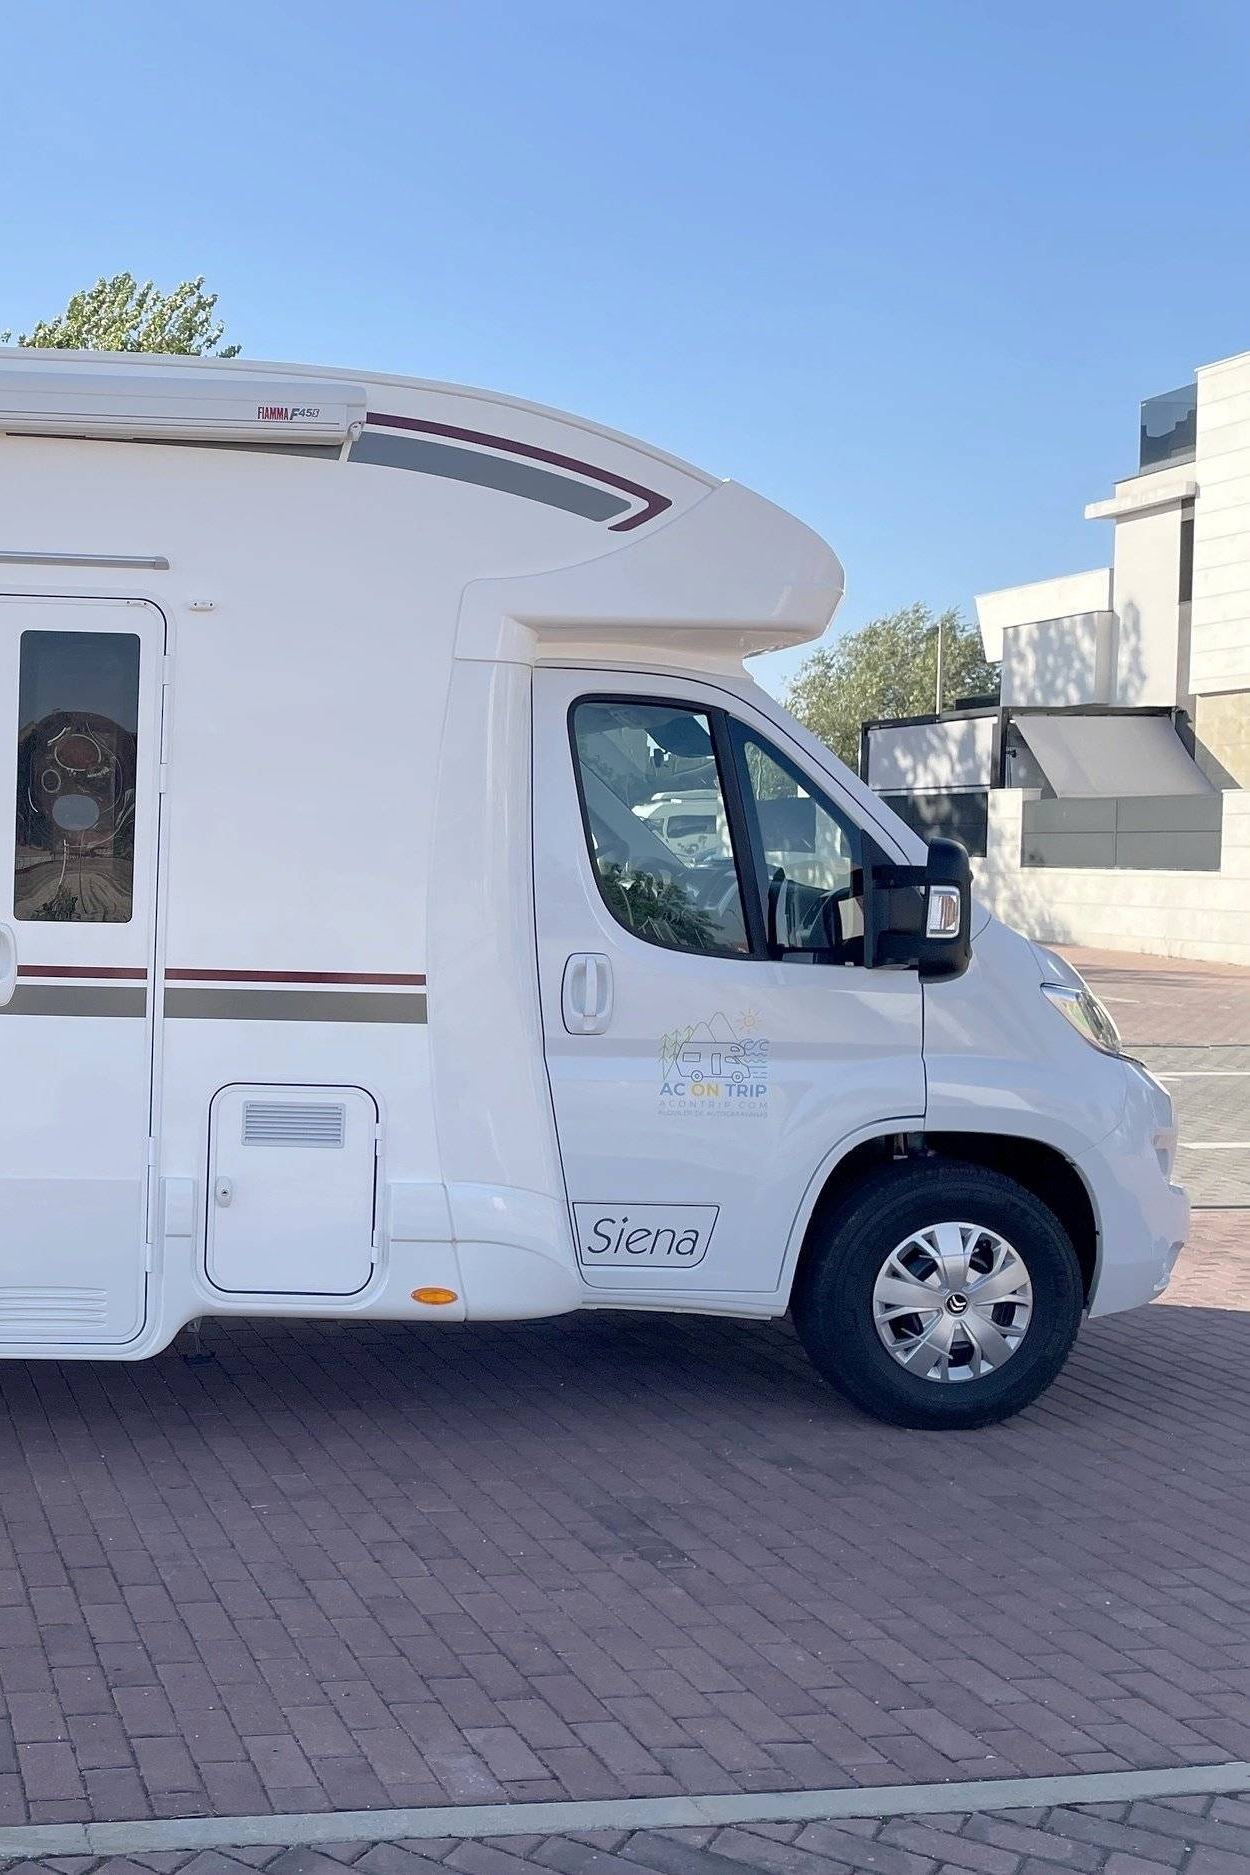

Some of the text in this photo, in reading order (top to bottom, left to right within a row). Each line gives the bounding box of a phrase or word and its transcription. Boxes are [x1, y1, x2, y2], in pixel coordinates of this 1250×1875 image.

[257, 406, 289, 420] FIAMMA
[659, 1082, 768, 1098] AC ON TRIP
[586, 1216, 700, 1256] Siena
